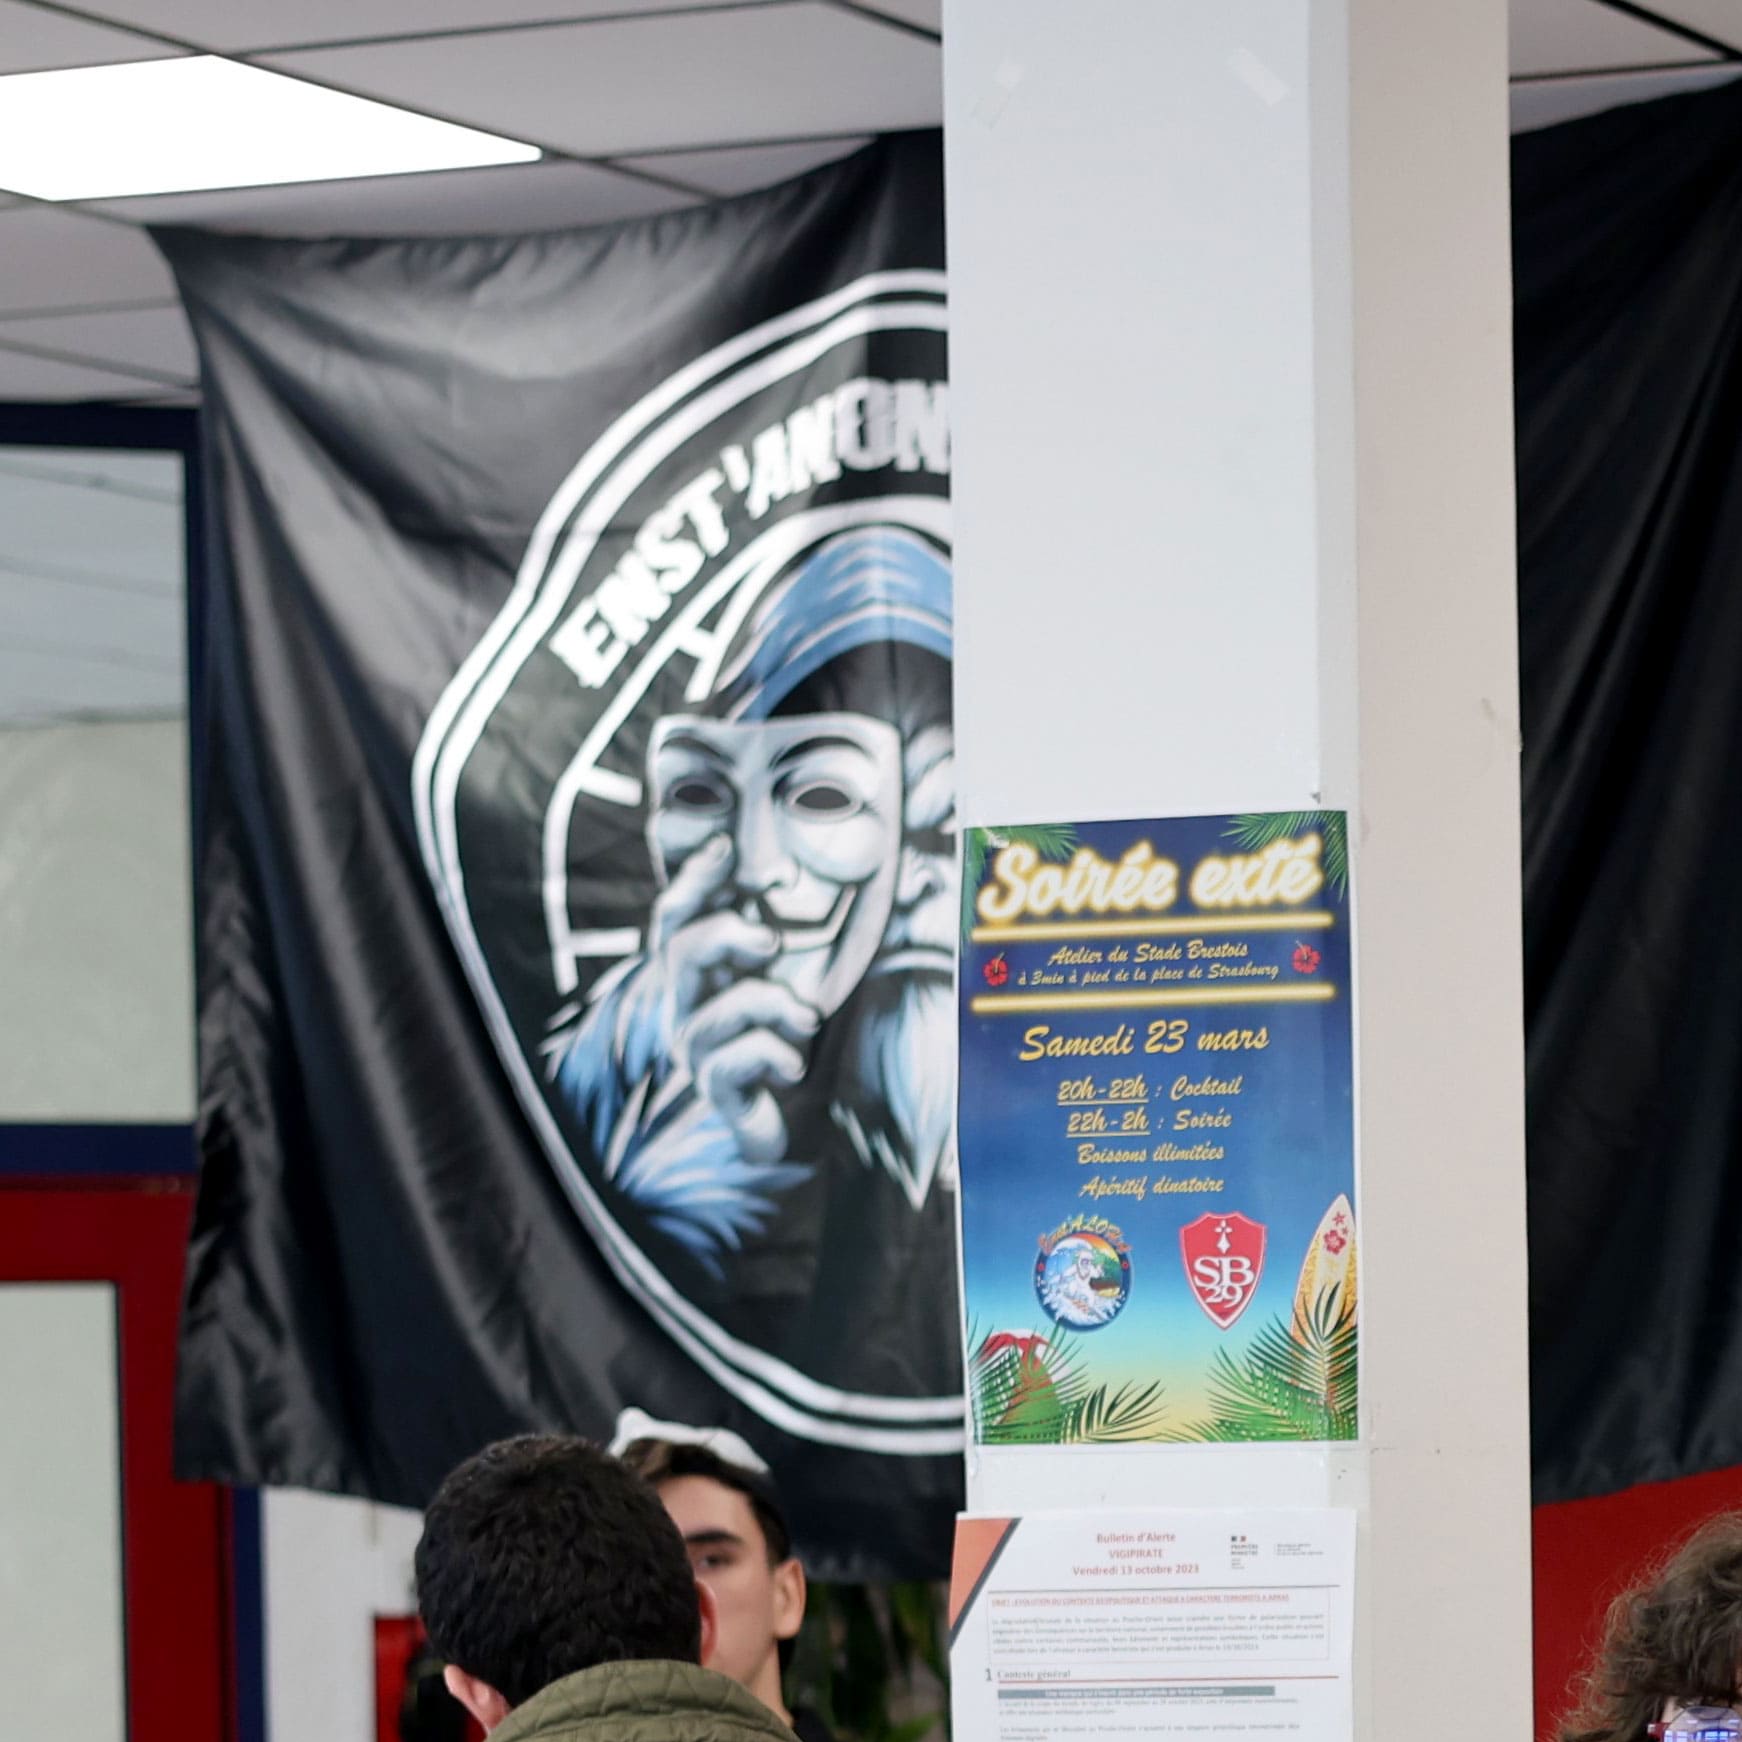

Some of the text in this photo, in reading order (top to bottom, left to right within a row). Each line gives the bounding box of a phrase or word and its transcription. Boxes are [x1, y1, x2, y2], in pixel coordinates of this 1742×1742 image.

[976, 832, 1324, 924] Soirée exté
[1047, 938, 1249, 966] Atelier du Stade Brestois
[1017, 961, 1280, 987] à 3min à pied de la place de Strasbourg
[1018, 1018, 1270, 1061] Samedi 23 mars
[1169, 1074, 1243, 1102] Cocktail
[1173, 1107, 1233, 1131] Soirée
[1077, 1140, 1225, 1165] Boissons illimitées
[1078, 1174, 1149, 1201] Apéritif
[1193, 1255, 1256, 1288] SB
[1204, 1284, 1243, 1309] 29
[1097, 1532, 1176, 1544] Bulletin d'Alerte
[1108, 1549, 1164, 1560] VIGIPIRATE
[1072, 1564, 1200, 1577] Vendredi 13 octobre 2023
[985, 1667, 992, 1682] 1
[1036, 1668, 1072, 1680] général
